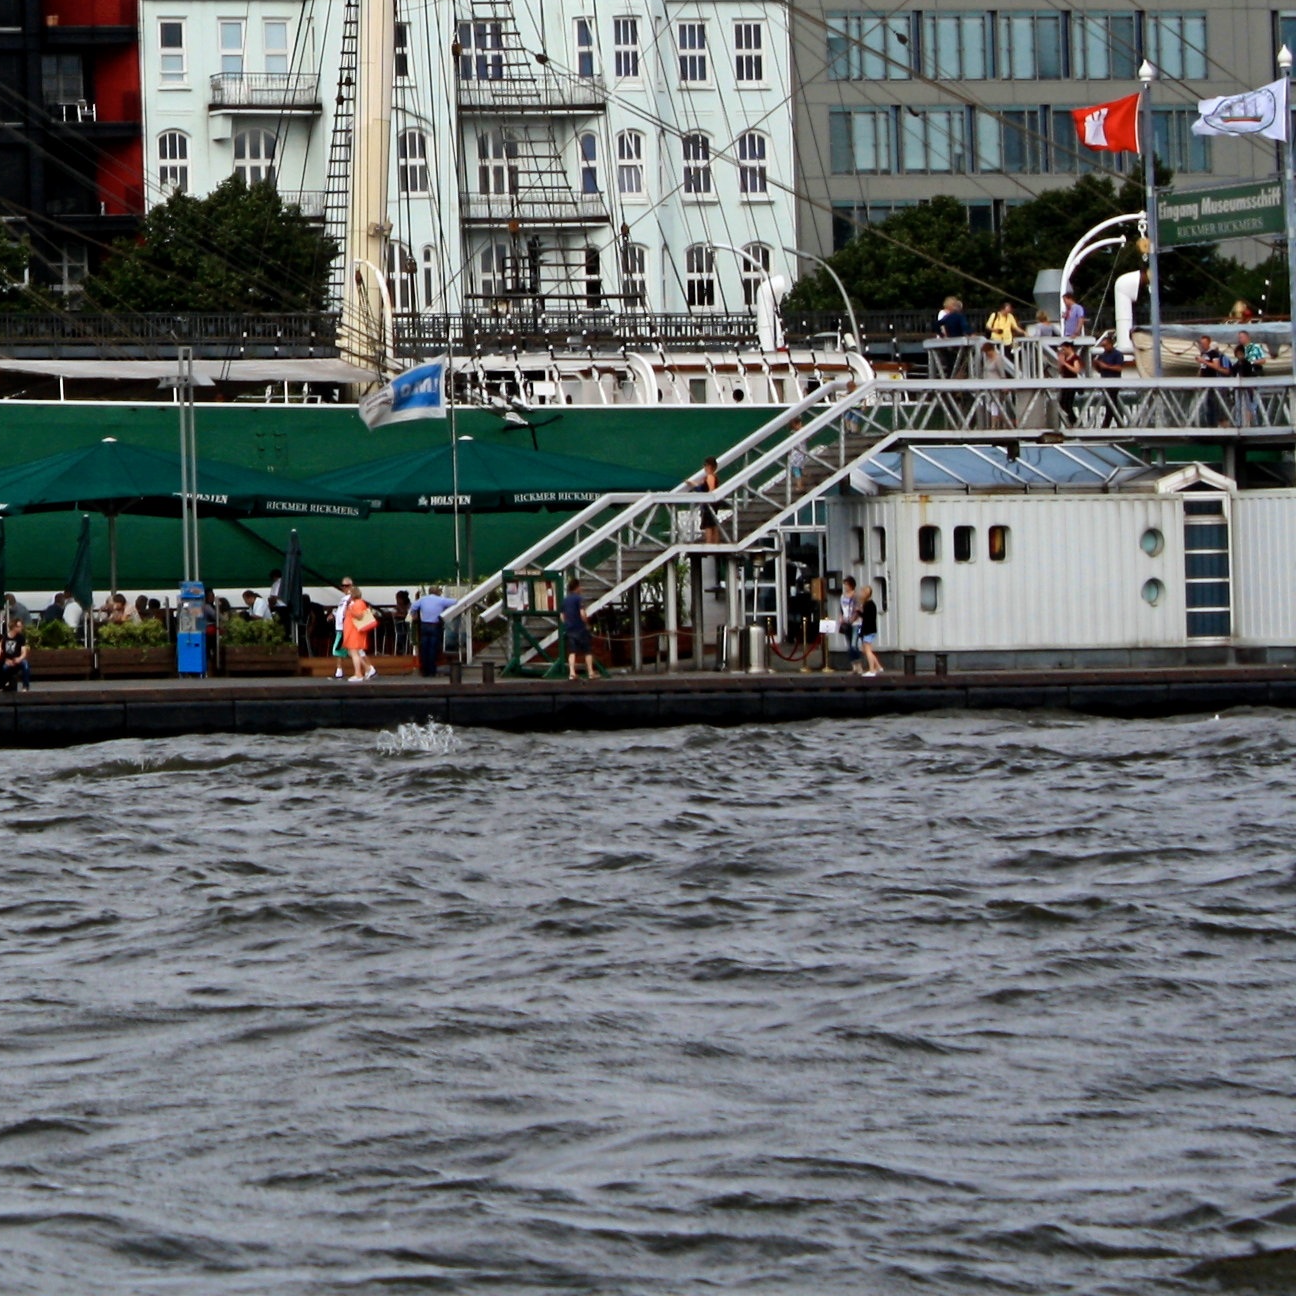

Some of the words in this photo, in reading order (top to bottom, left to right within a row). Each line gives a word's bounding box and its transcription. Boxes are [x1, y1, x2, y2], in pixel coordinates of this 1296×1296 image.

[1158, 201, 1199, 222] Eingang
[1200, 187, 1281, 216] Museumsschiff
[430, 495, 471, 505] HOLSEN
[514, 493, 556, 503] RICKMER
[558, 492, 604, 502] RICKMER
[266, 501, 308, 512] RICKMER
[310, 504, 359, 517] RICKMERS
